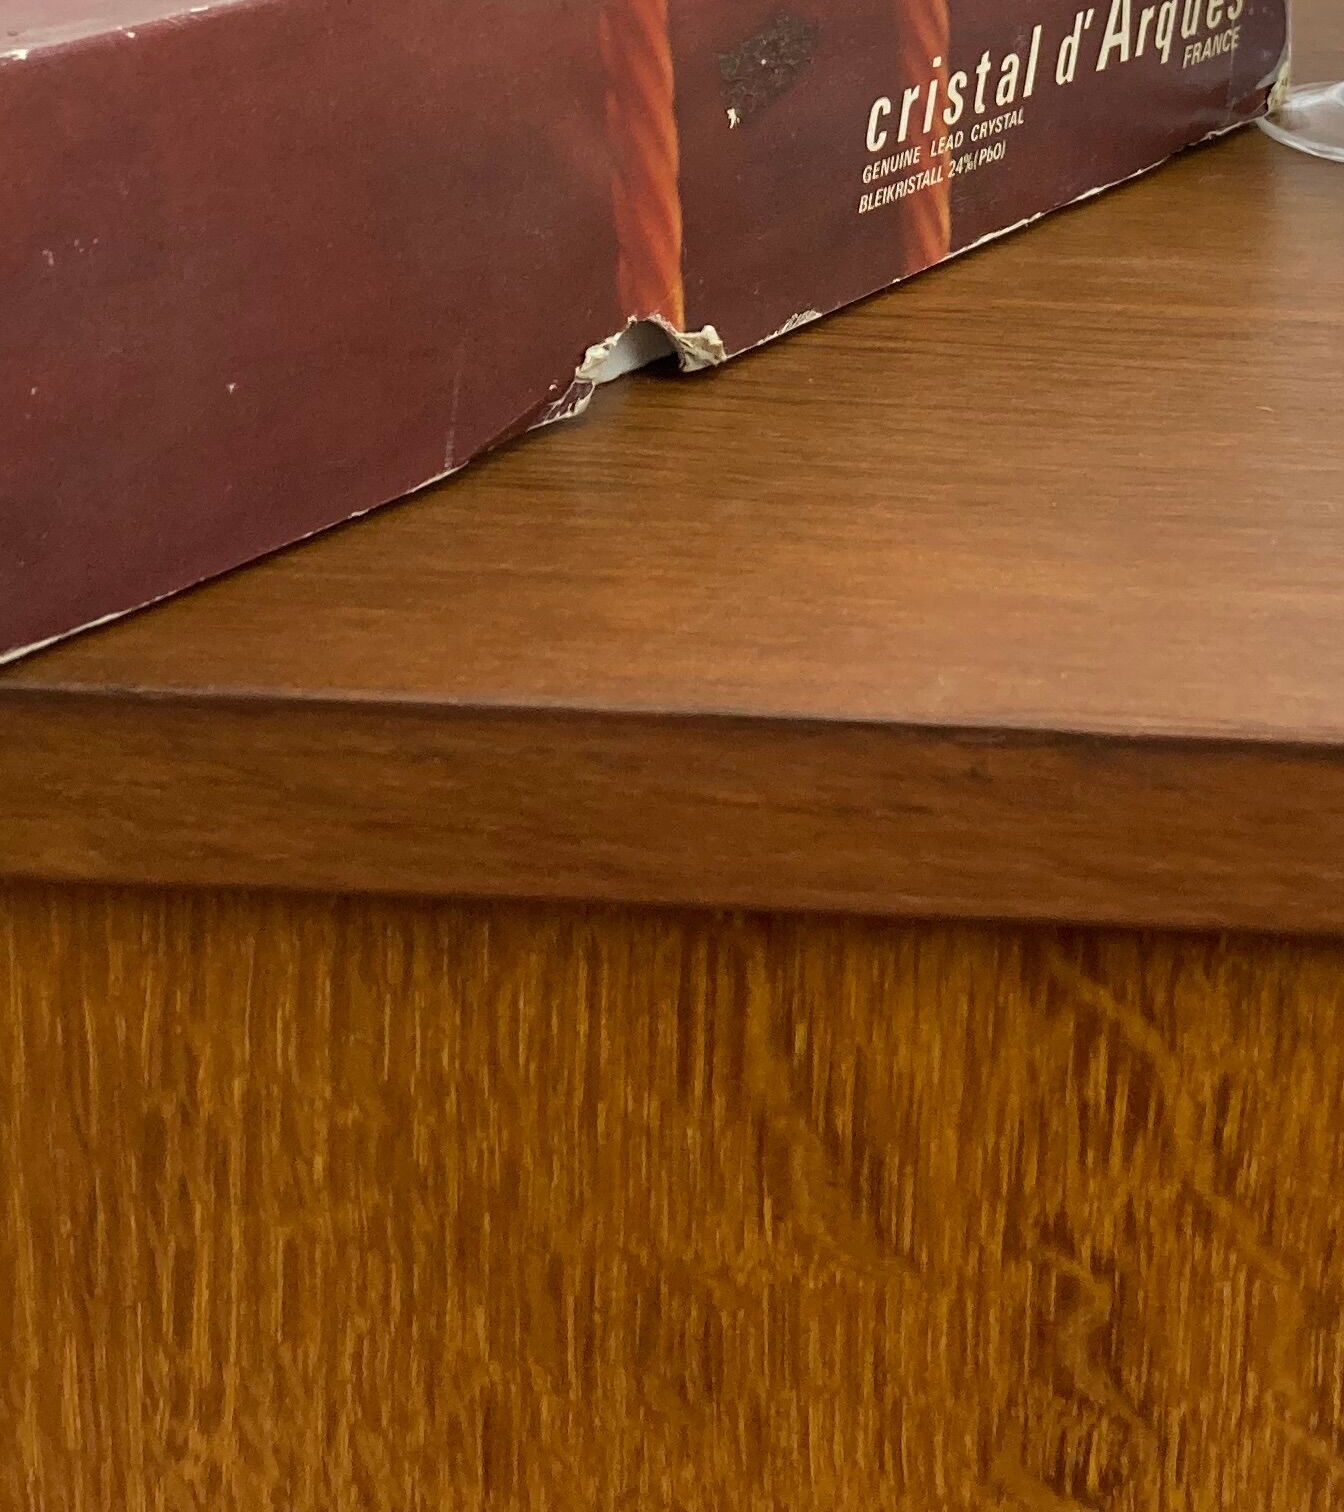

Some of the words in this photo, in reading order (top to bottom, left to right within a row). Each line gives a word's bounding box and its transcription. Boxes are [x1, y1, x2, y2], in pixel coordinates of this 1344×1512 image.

[1182, 25, 1241, 69] FRANCE
[864, 24, 1043, 153] cristal
[862, 146, 922, 184] GENUINE
[930, 131, 964, 157] LEAD
[970, 107, 1025, 142] CRYSTAL
[858, 165, 944, 214] BLEIKRISTALL
